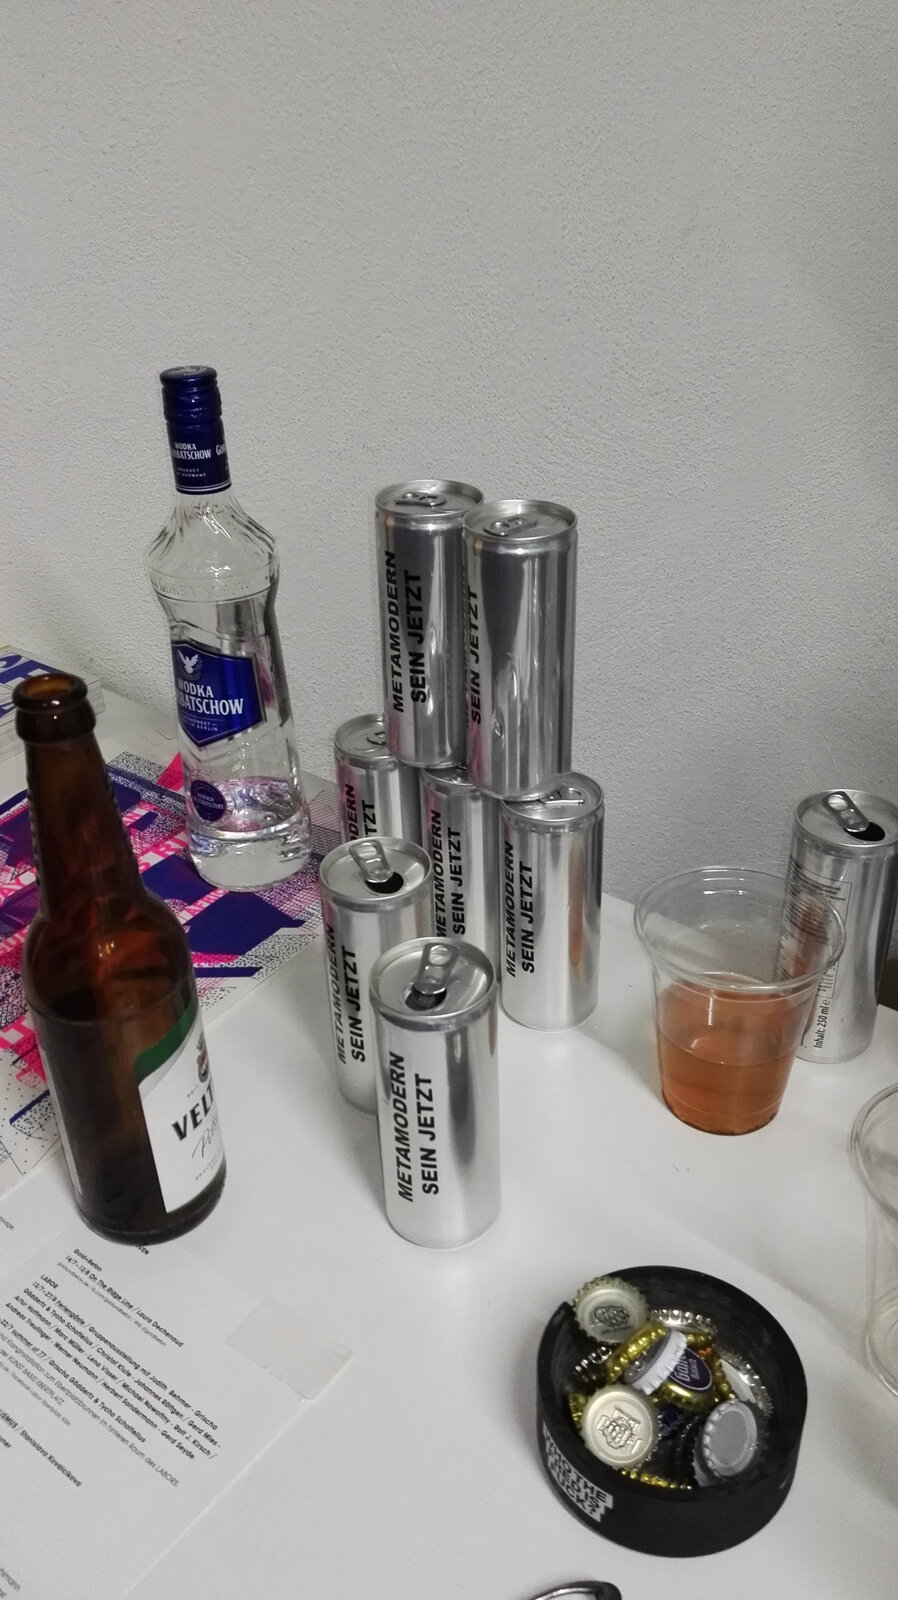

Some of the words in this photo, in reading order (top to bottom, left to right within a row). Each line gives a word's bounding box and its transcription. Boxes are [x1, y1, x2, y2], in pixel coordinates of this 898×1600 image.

[174, 442, 197, 451] WODKA
[385, 550, 404, 713] METAMODERN
[404, 570, 424, 645] JETZT
[467, 585, 480, 664] JETZT
[408, 651, 427, 703] SEIN
[470, 670, 481, 724] SEIN
[430, 810, 447, 937] METAMODERN
[447, 827, 463, 887] JETZT
[451, 892, 466, 935] SEIN
[504, 840, 516, 978] METAMODERN
[519, 861, 533, 924] JETZT
[342, 945, 361, 1012] JETZT
[521, 928, 535, 973] SEIN
[325, 922, 346, 1064] METAMODERN
[816, 1015, 828, 1028] 250
[819, 1005, 829, 1015] ml
[348, 1015, 366, 1063] SEIN
[813, 1028, 826, 1049] Inhalt:
[389, 1051, 413, 1203] METAMODERN
[414, 1073, 436, 1142] JETZT
[419, 1147, 439, 1195] SEIN
[40, 1274, 59, 1289] LABOR
[105, 1287, 122, 1302] Ridge
[120, 1298, 134, 1310] Line
[136, 1309, 153, 1324] Laura
[5, 1302, 27, 1321] Andreas
[53, 1341, 73, 1359] Werner
[72, 1357, 98, 1380] Neumann
[101, 1381, 124, 1400] Herbert
[122, 1398, 158, 1429] Sondermann
[161, 1430, 177, 1444] Gerd
[175, 1442, 195, 1459] Seyde
[48, 1360, 70, 1379] Grischa
[99, 1401, 116, 1417] Tycho
[50, 1309, 66, 1324] Tycho
[96, 1347, 119, 1366] Christof
[134, 1379, 162, 1401] Johannes
[187, 1420, 205, 1435] Gerd
[202, 1432, 218, 1446] Mies
[54, 1327, 69, 1341] Marc
[67, 1338, 85, 1354] Müller
[87, 1354, 101, 1368] Lena
[101, 1365, 119, 1381] Visser
[121, 1382, 145, 1402] Michael
[191, 1439, 211, 1456] Kirsch
[88, 1326, 141, 1370] Gruppenausstellung
[139, 1368, 151, 1377] mit
[149, 1376, 168, 1391] Judith
[194, 1410, 218, 1430] Grischa
[574, 1471, 607, 1503] THE
[584, 1491, 600, 1509] IS
